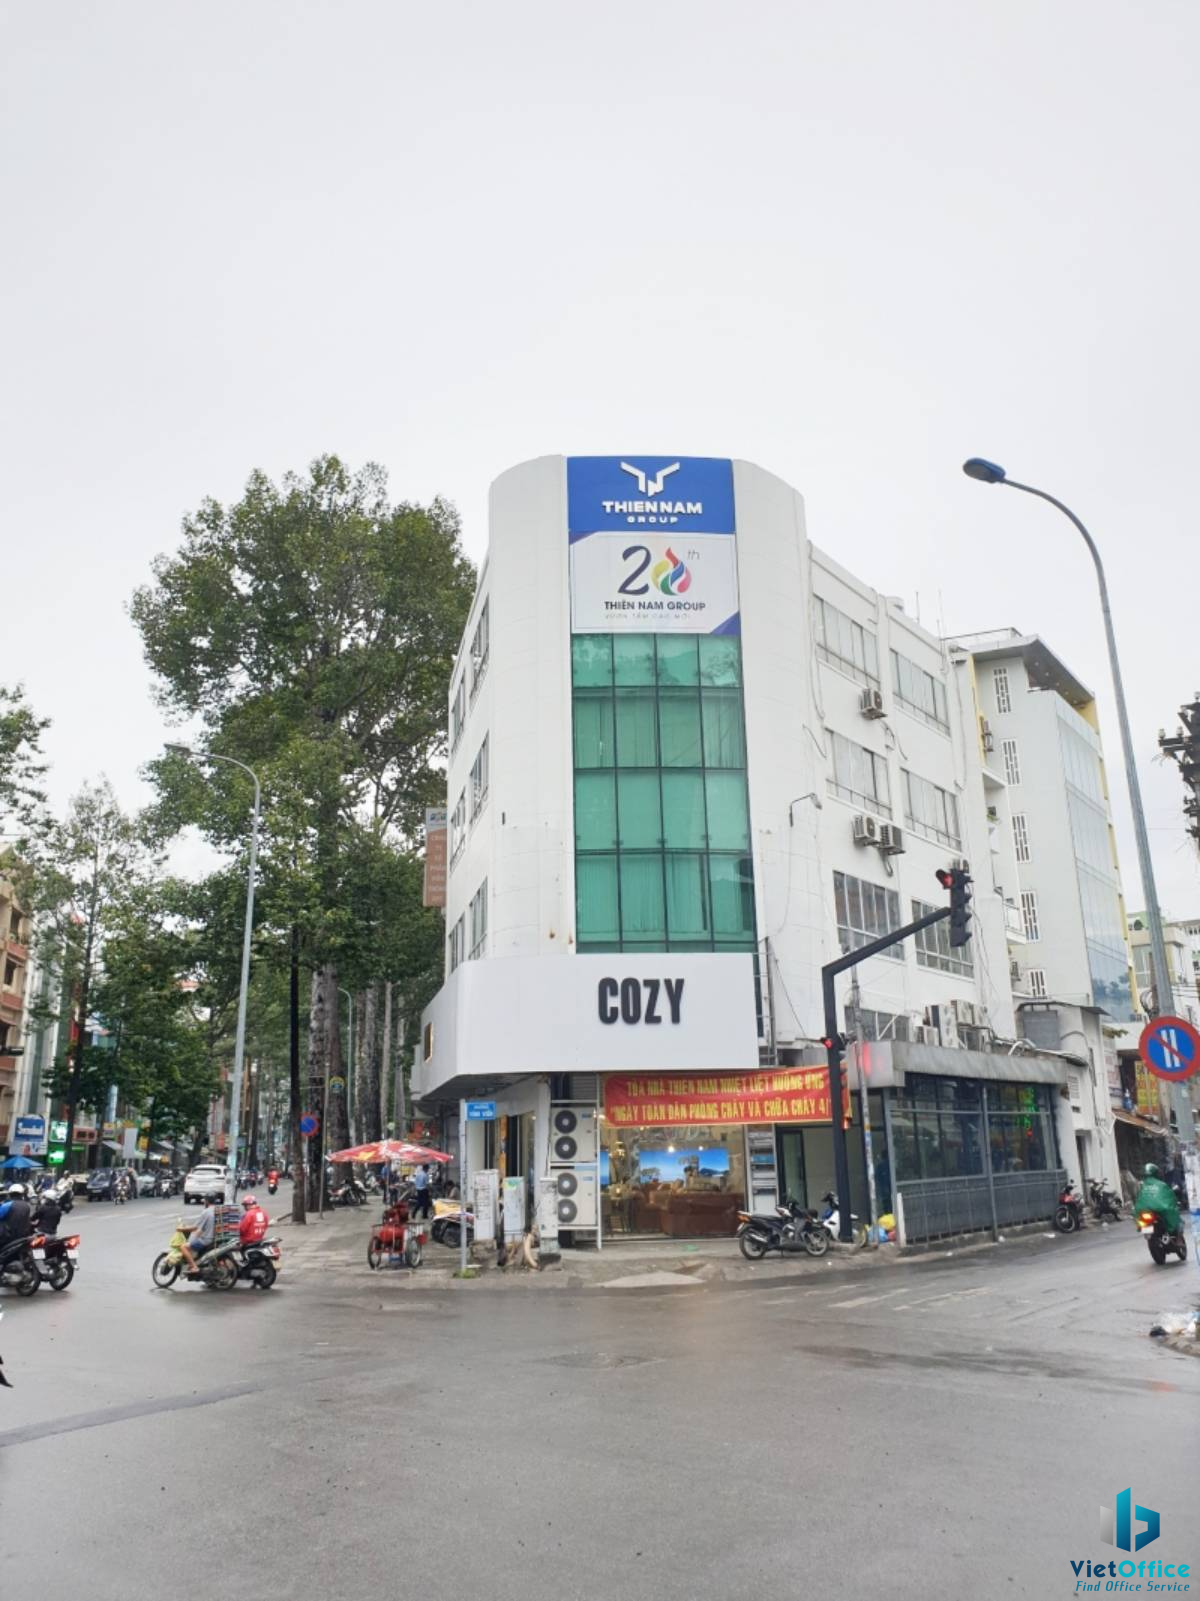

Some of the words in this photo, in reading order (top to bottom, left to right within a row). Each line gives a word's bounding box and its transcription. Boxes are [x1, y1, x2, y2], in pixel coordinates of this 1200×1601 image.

[627, 516, 679, 524] GROUP
[604, 600, 635, 610] THIÊN
[638, 602, 664, 610] NAM
[667, 602, 706, 611] GROUP
[598, 977, 685, 1025] COZY
[721, 1099, 745, 1119] CHÁY
[748, 1098, 762, 1117] VÀ
[791, 1096, 816, 1116] CHÁY
